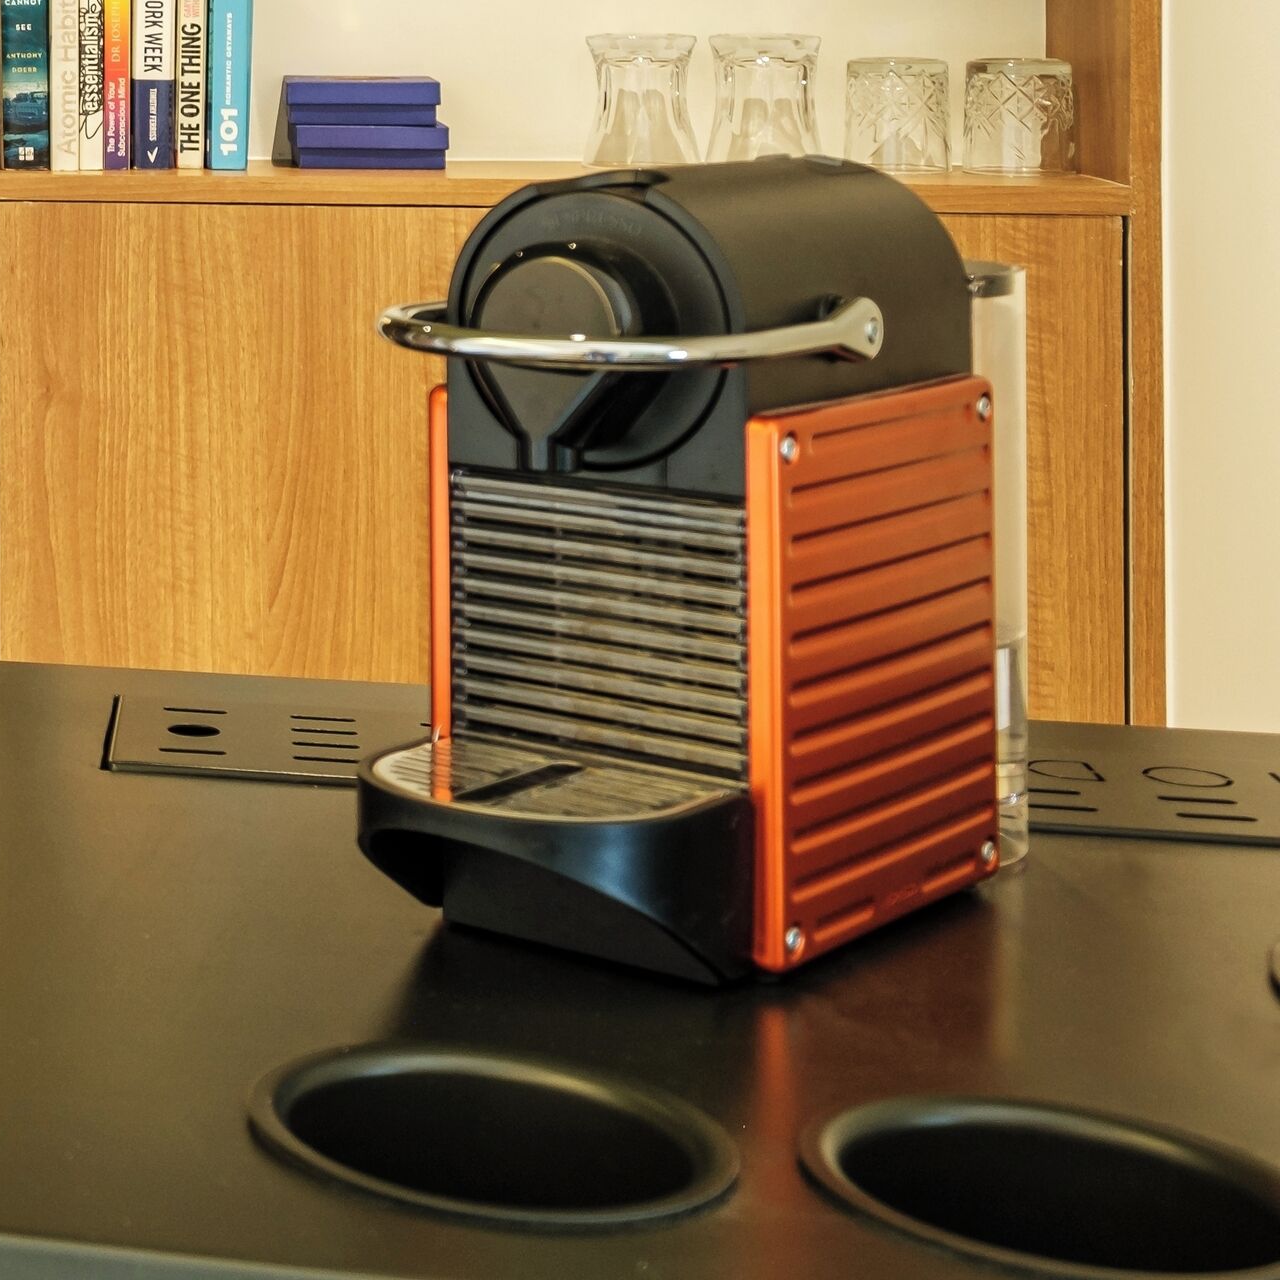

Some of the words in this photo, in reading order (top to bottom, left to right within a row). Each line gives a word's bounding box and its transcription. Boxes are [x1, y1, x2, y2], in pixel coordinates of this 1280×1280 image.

[15, 23, 32, 31] SEE
[112, 2, 122, 43] JOSEPH
[224, 12, 233, 58] GETAWAYS
[81, 12, 100, 112] essentialism
[111, 45, 121, 62] DR
[143, 32, 162, 73] WEEK
[181, 23, 201, 76] THING
[11, 66, 38, 74] DOERR
[117, 78, 126, 98] Mind
[225, 60, 233, 106] ROMANTIC
[107, 81, 116, 100] Your
[107, 101, 116, 110] of
[180, 81, 200, 118] ONE
[57, 69, 77, 156] Atomic
[107, 111, 116, 137] Power
[117, 99, 126, 157] Subconscious
[107, 138, 116, 153] The
[179, 123, 200, 154] THE
[219, 107, 239, 156] 101
